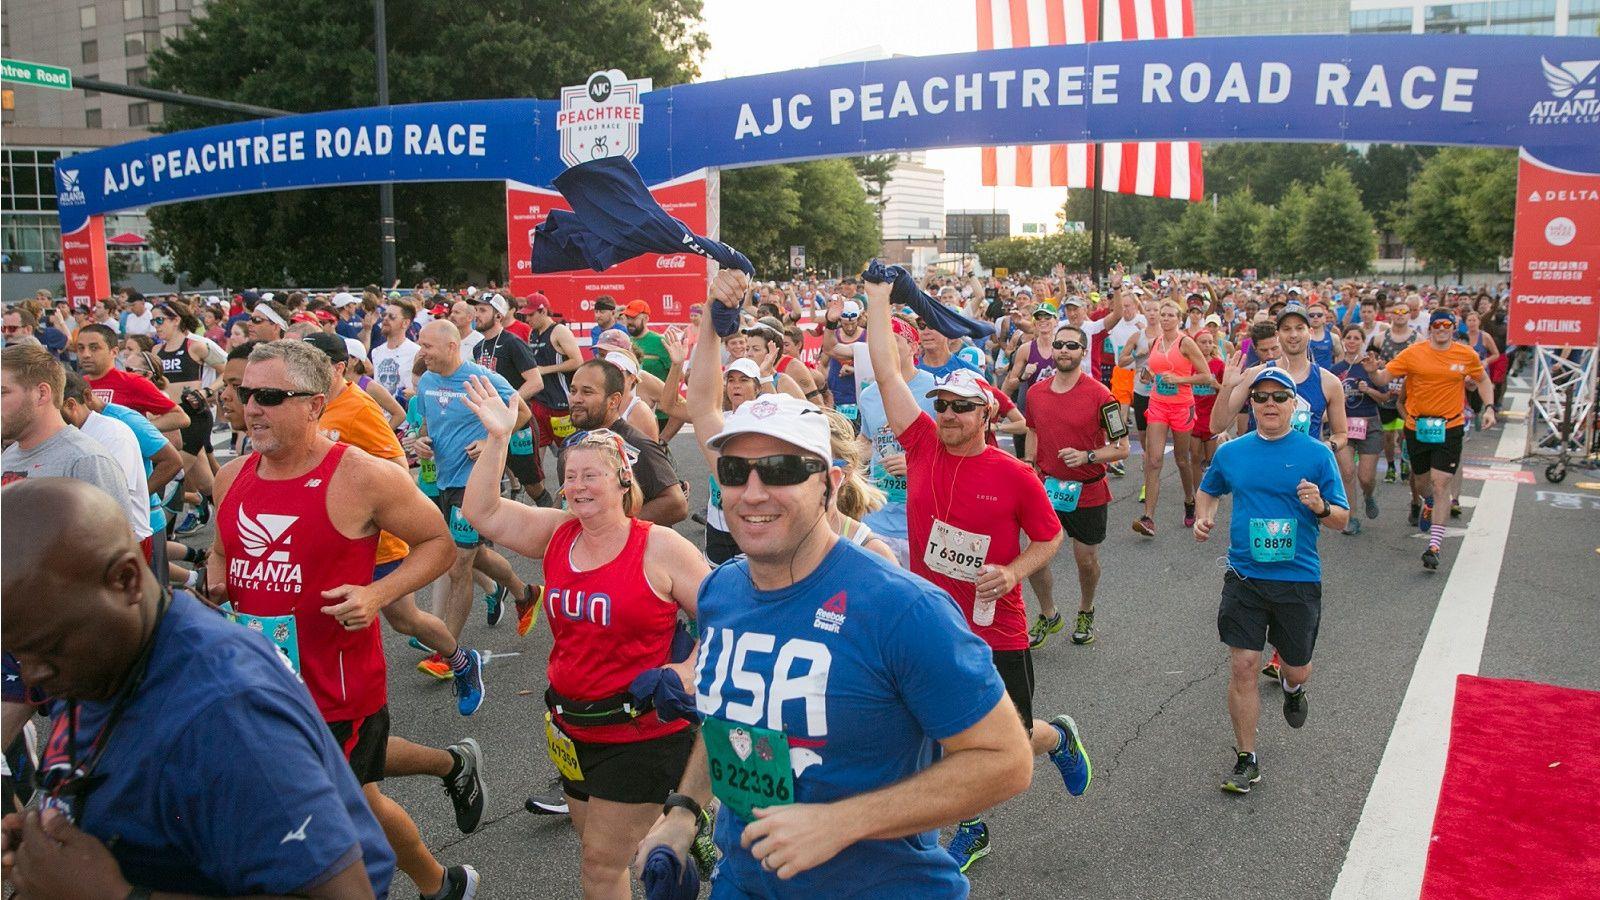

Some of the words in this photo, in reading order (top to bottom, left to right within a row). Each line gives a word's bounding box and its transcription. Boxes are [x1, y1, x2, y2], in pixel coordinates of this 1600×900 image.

[37, 69, 66, 85] Road
[591, 83, 609, 97] AJC
[734, 94, 813, 141] AJC
[830, 64, 1119, 125] PEACHTREE
[1141, 62, 1292, 103] ROAD
[1315, 62, 1479, 113] RACE
[559, 106, 641, 127] PEACHTREE
[1529, 116, 1569, 125] TRACK
[103, 160, 145, 196] AJC
[152, 129, 306, 183] PEACHTREE
[316, 124, 394, 159] ROAD
[404, 123, 487, 157] RACE
[1545, 190, 1600, 201] DELTA
[1528, 261, 1589, 271] WAFFLE
[1532, 270, 1583, 280] HOUSE
[601, 283, 625, 291] PARTNERS
[1517, 294, 1592, 305] POWERADE
[1535, 319, 1582, 333] ATHLINKS
[884, 480, 907, 490] 7928
[1254, 538, 1261, 548] C
[1264, 538, 1292, 549] 8878
[929, 541, 938, 554] T
[939, 547, 983, 569] 63095
[230, 558, 303, 584] ATLANTA
[230, 576, 260, 591] TRACK
[266, 582, 302, 594] CLUB
[547, 588, 611, 627] run
[815, 608, 846, 624] Reebok
[694, 627, 832, 737] USA
[551, 741, 578, 770] 47359
[711, 758, 723, 781] G
[728, 763, 790, 801] 22336
